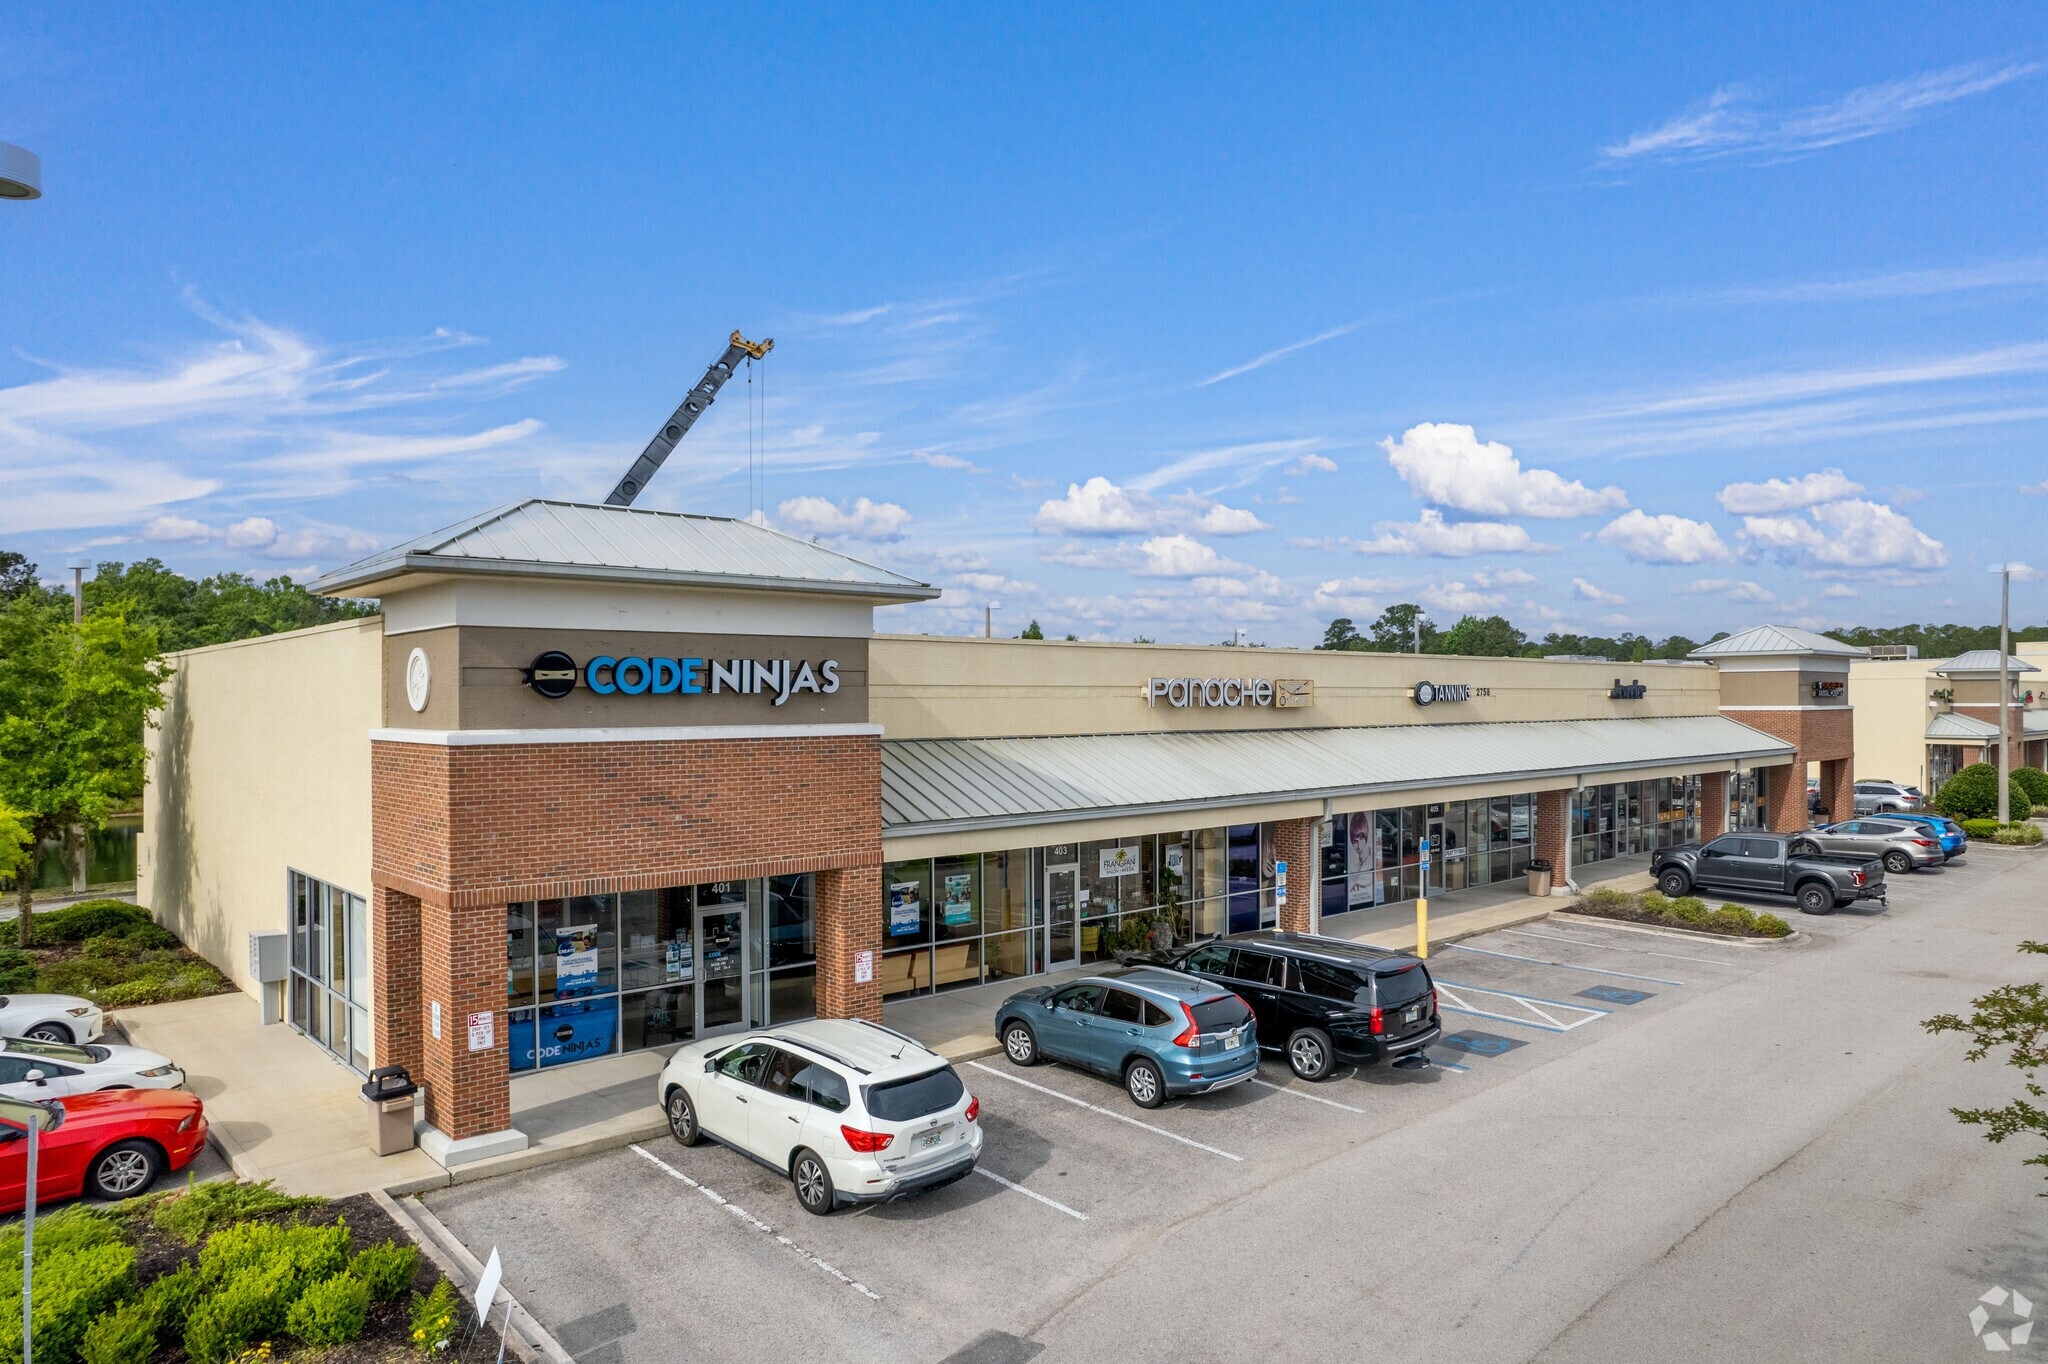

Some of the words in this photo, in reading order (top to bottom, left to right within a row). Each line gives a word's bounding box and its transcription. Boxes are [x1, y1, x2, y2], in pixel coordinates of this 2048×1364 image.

[584, 656, 702, 695] CODE
[708, 659, 840, 707] NINJAS
[1434, 685, 1472, 701] TANNING
[1476, 688, 1490, 696] 2758
[1054, 846, 1067, 855] 403
[711, 882, 730, 893] 401
[470, 1015, 478, 1026] 15
[526, 1046, 561, 1059] CODE
[562, 1038, 600, 1054] NINJAS
